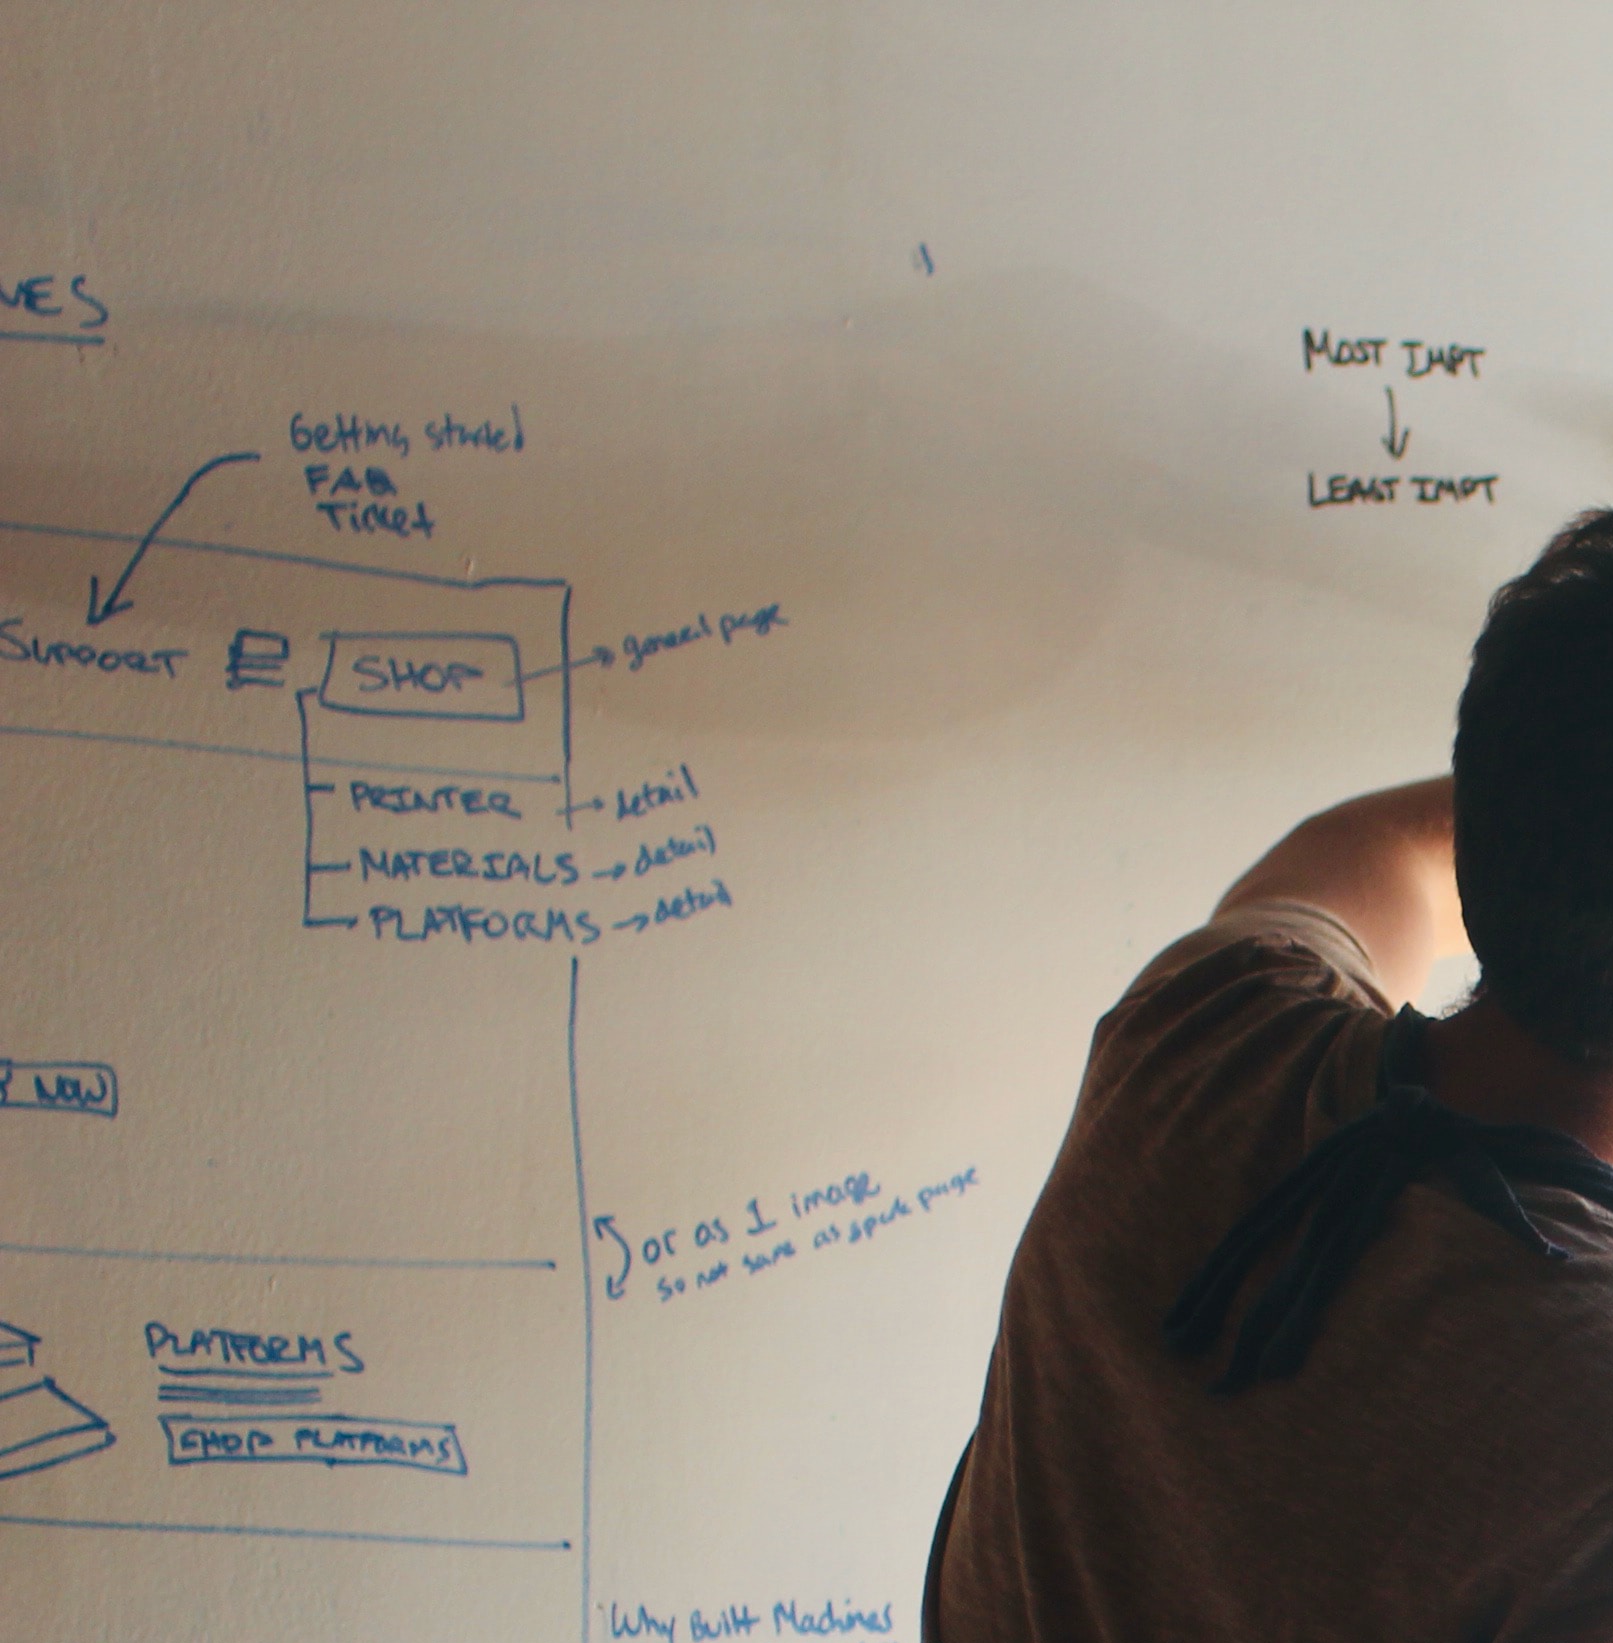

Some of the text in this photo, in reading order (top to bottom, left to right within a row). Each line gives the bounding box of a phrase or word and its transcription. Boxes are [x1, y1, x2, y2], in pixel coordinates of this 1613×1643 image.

[1303, 325, 1486, 380] MOST IMPT
[1307, 468, 1500, 510] LEAST IMPT
[315, 500, 435, 540] Ticket
[351, 656, 485, 696] SHOP
[350, 762, 700, 821] PRINTER detail
[358, 822, 716, 886] MATERIALS detail
[368, 903, 602, 946] PLATFORMS
[641, 1227, 677, 1265] or
[693, 1217, 730, 1248] as
[790, 1170, 882, 1219] image
[657, 1275, 686, 1302] so
[695, 1259, 730, 1289] not
[812, 1223, 841, 1250] as
[144, 1320, 366, 1375] PLATFORMS
[180, 1428, 451, 1467] SHOP PLATFORMS
[772, 1598, 894, 1636] Machines
